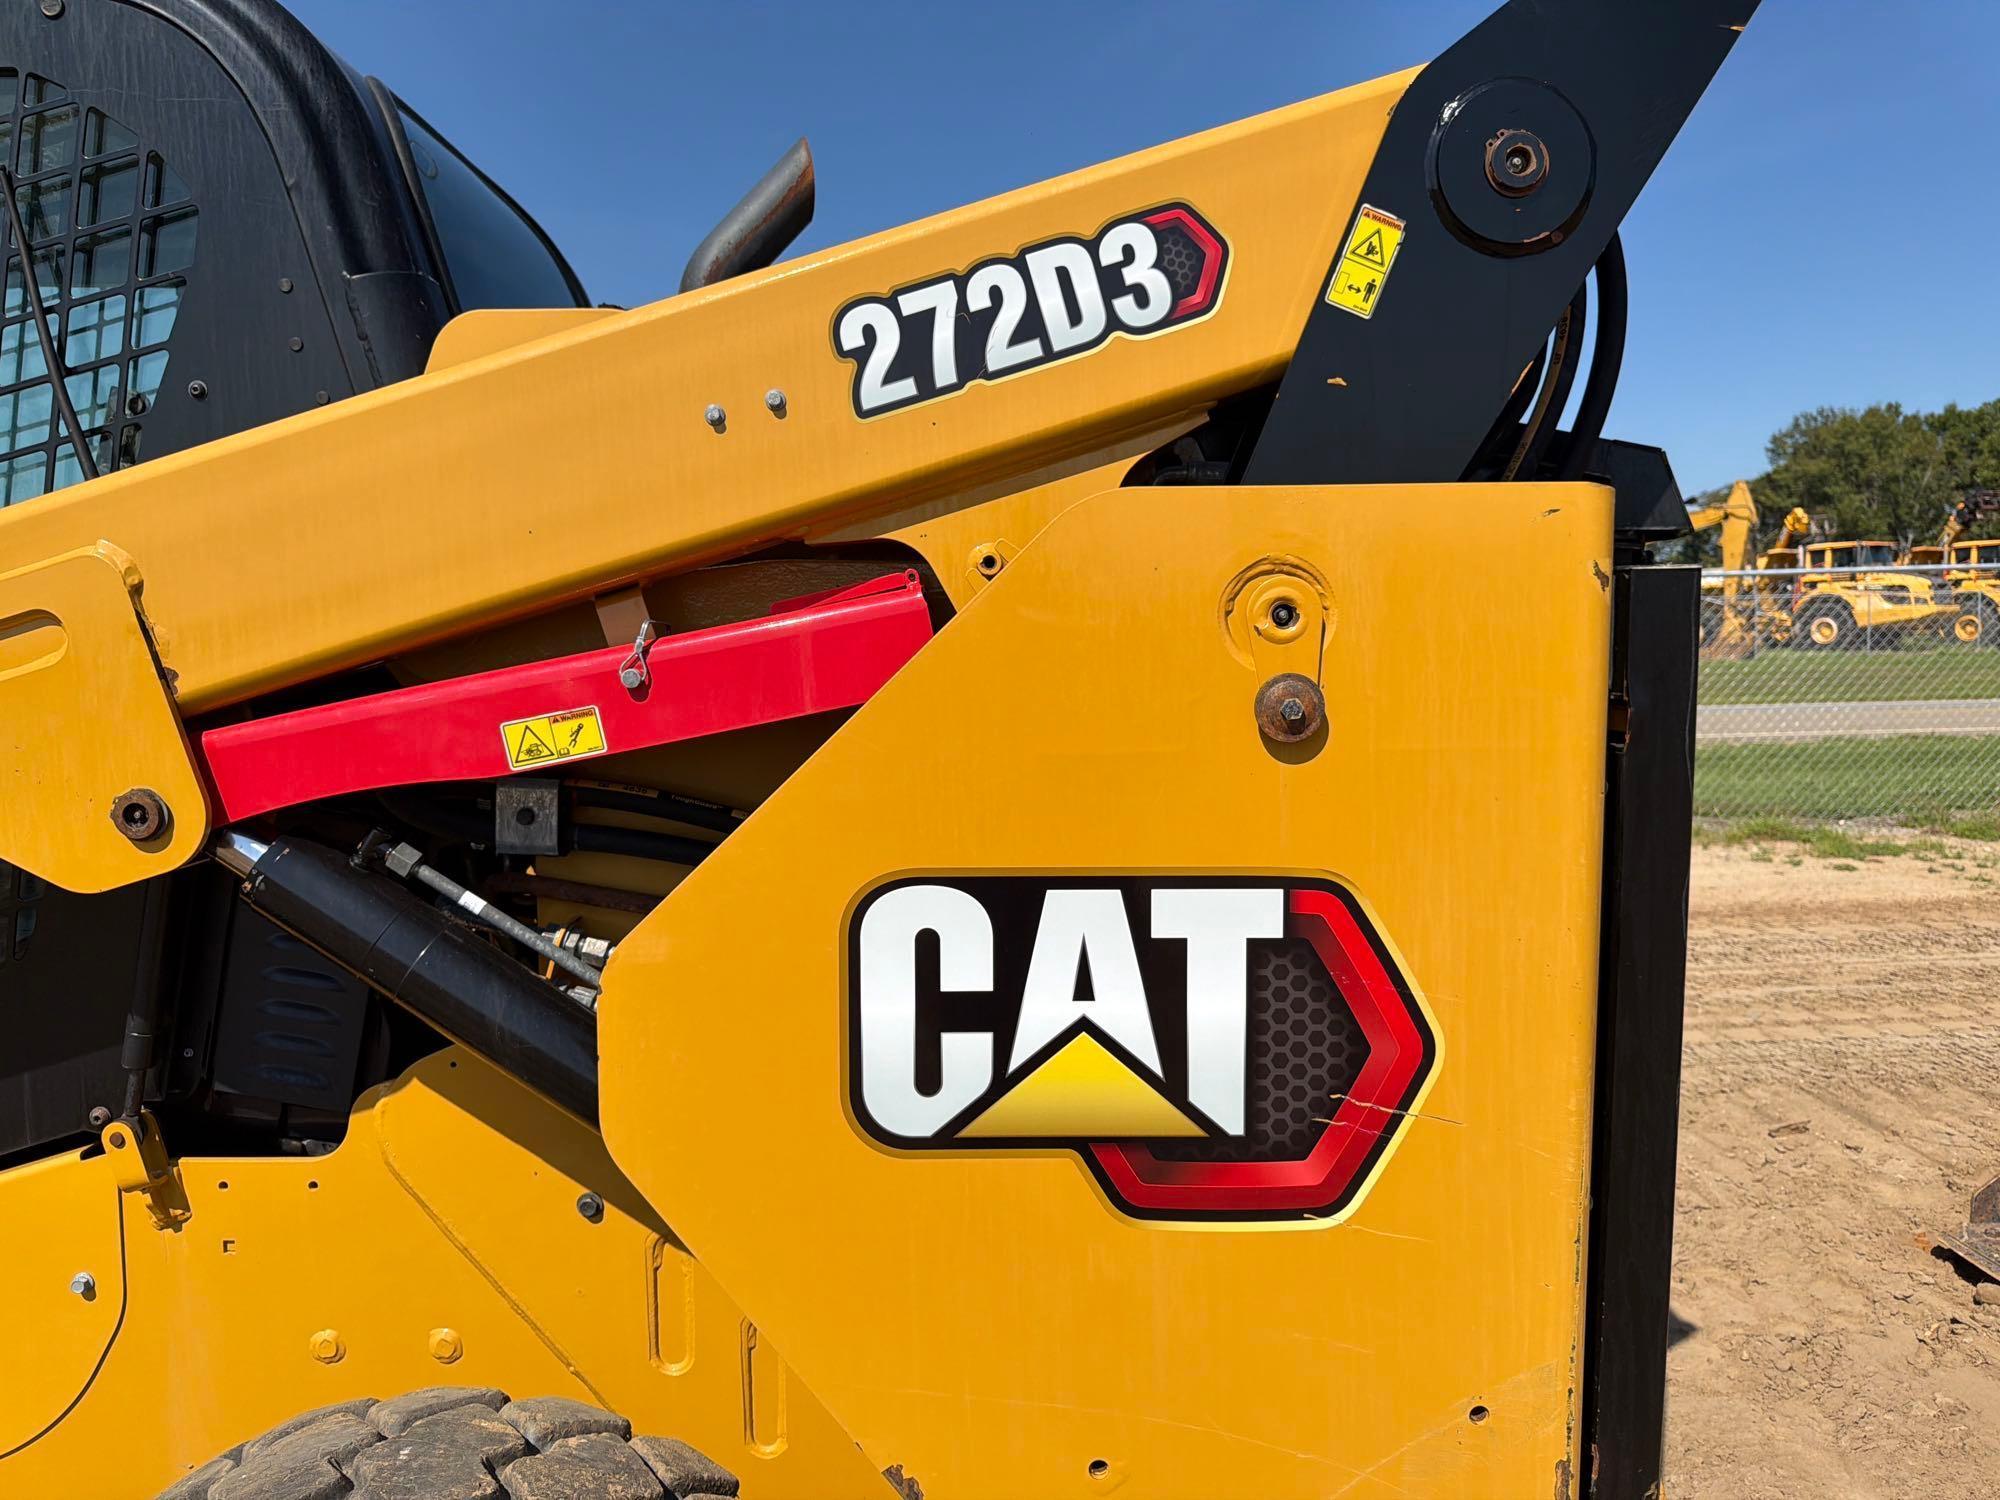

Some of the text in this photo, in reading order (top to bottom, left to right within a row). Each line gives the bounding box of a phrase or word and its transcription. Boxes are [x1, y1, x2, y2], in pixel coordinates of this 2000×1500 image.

[1371, 214, 1402, 231] WARNING
[839, 222, 1173, 411] 272D3
[560, 711, 593, 722] WARNING
[860, 884, 1284, 1138] CAT
